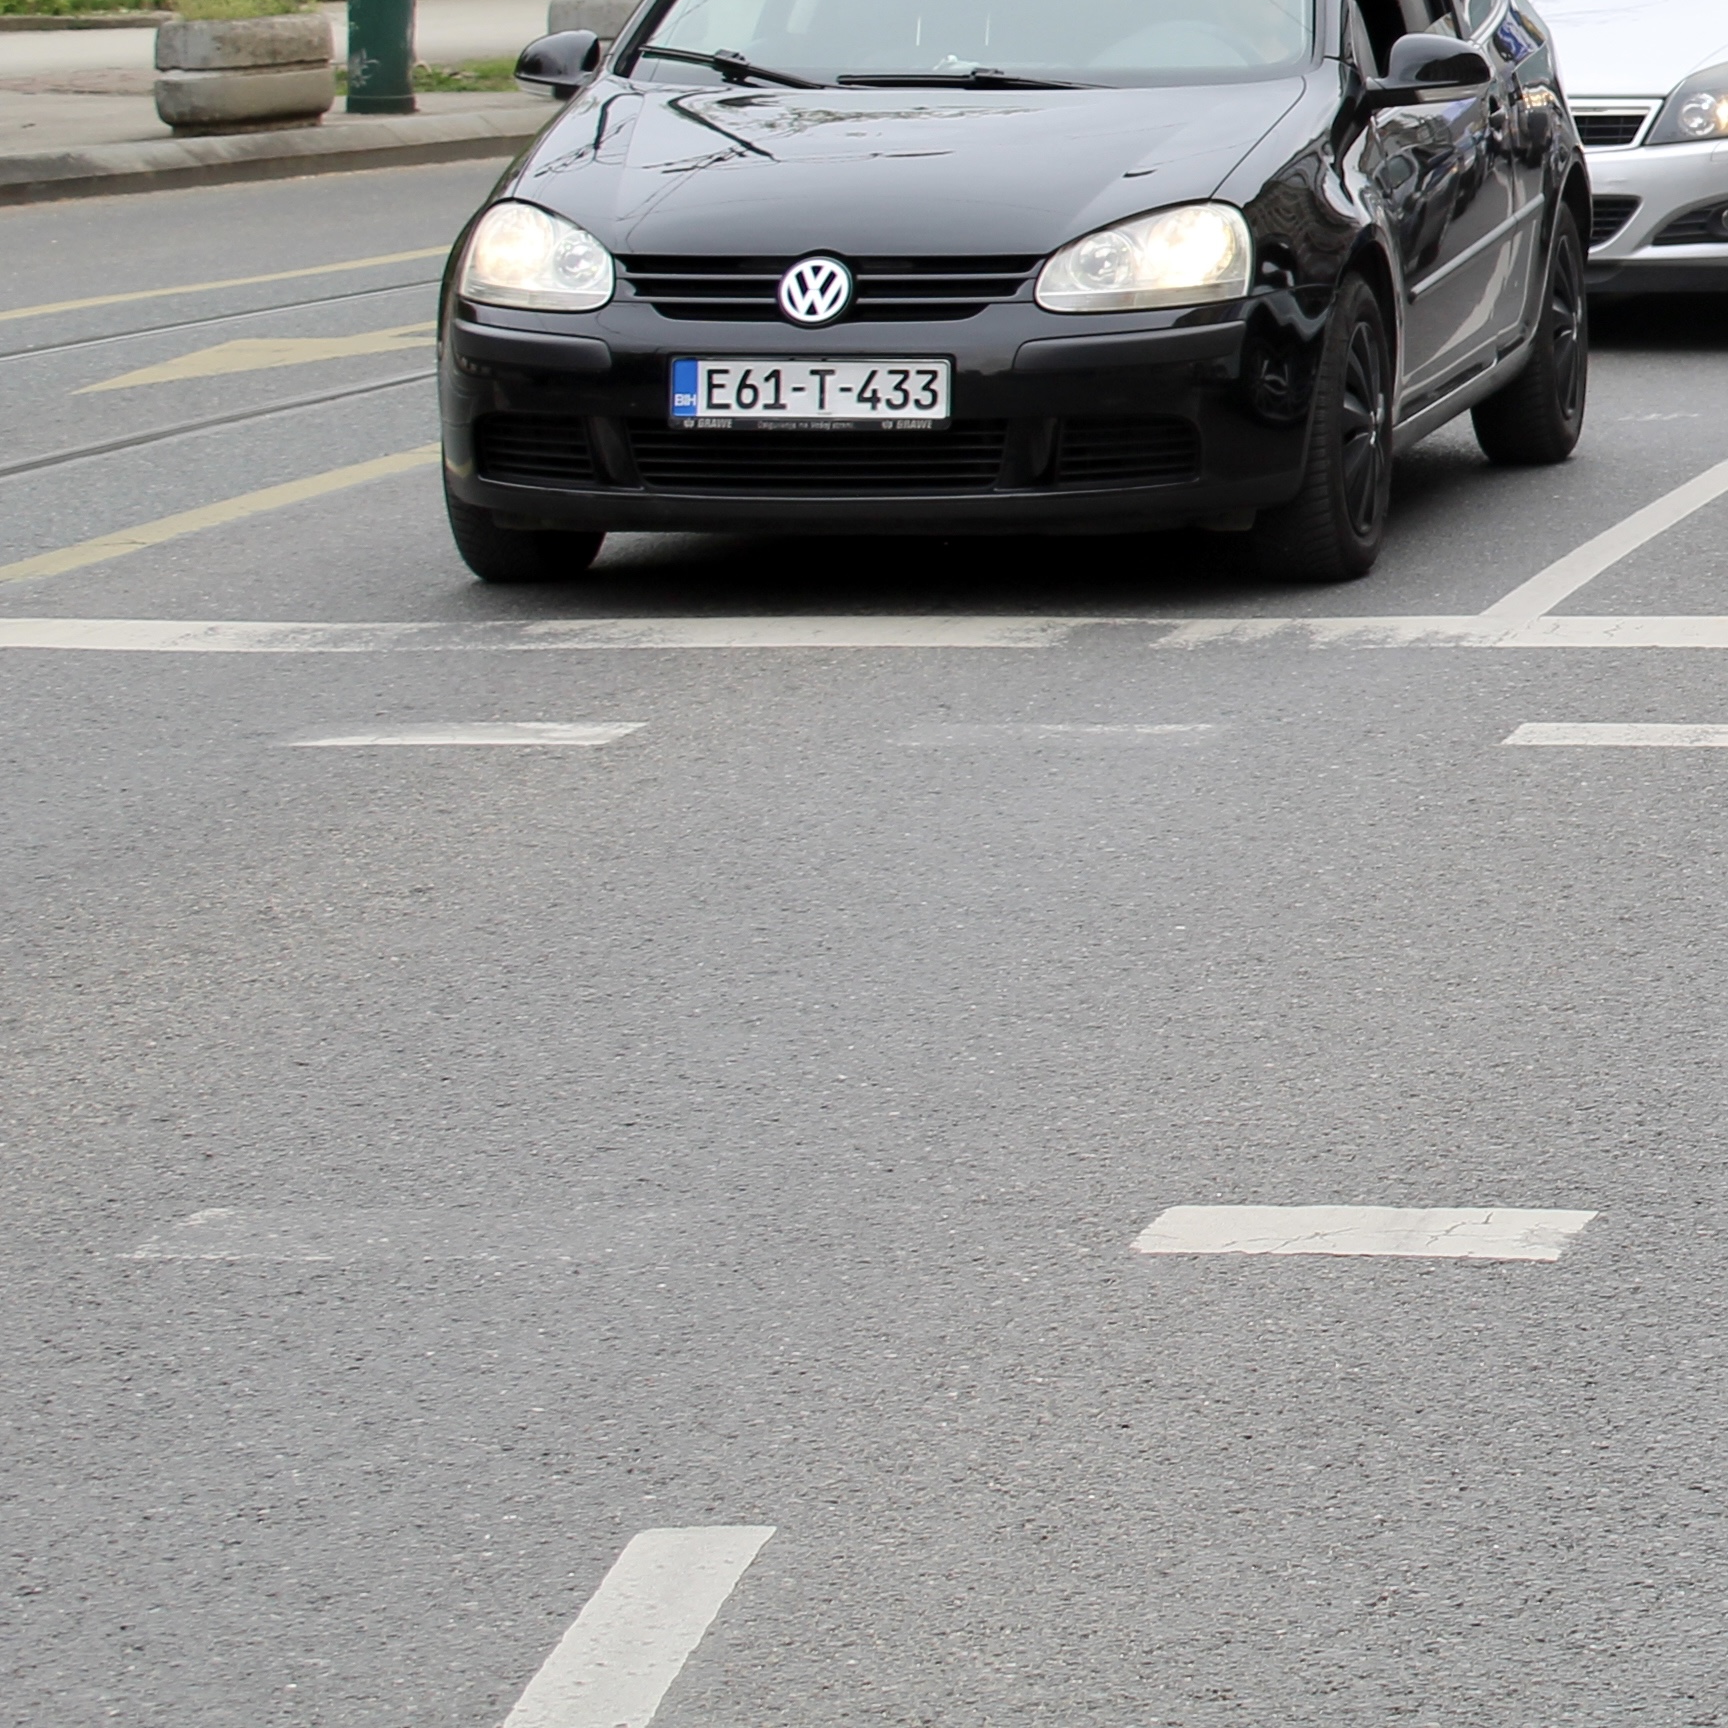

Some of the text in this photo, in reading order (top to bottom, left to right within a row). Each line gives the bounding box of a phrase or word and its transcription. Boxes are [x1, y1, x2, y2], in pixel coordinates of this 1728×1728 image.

[674, 368, 939, 411] BIH E61-T-433
[697, 418, 733, 429] GRAWE
[896, 418, 934, 429] GRAWE
